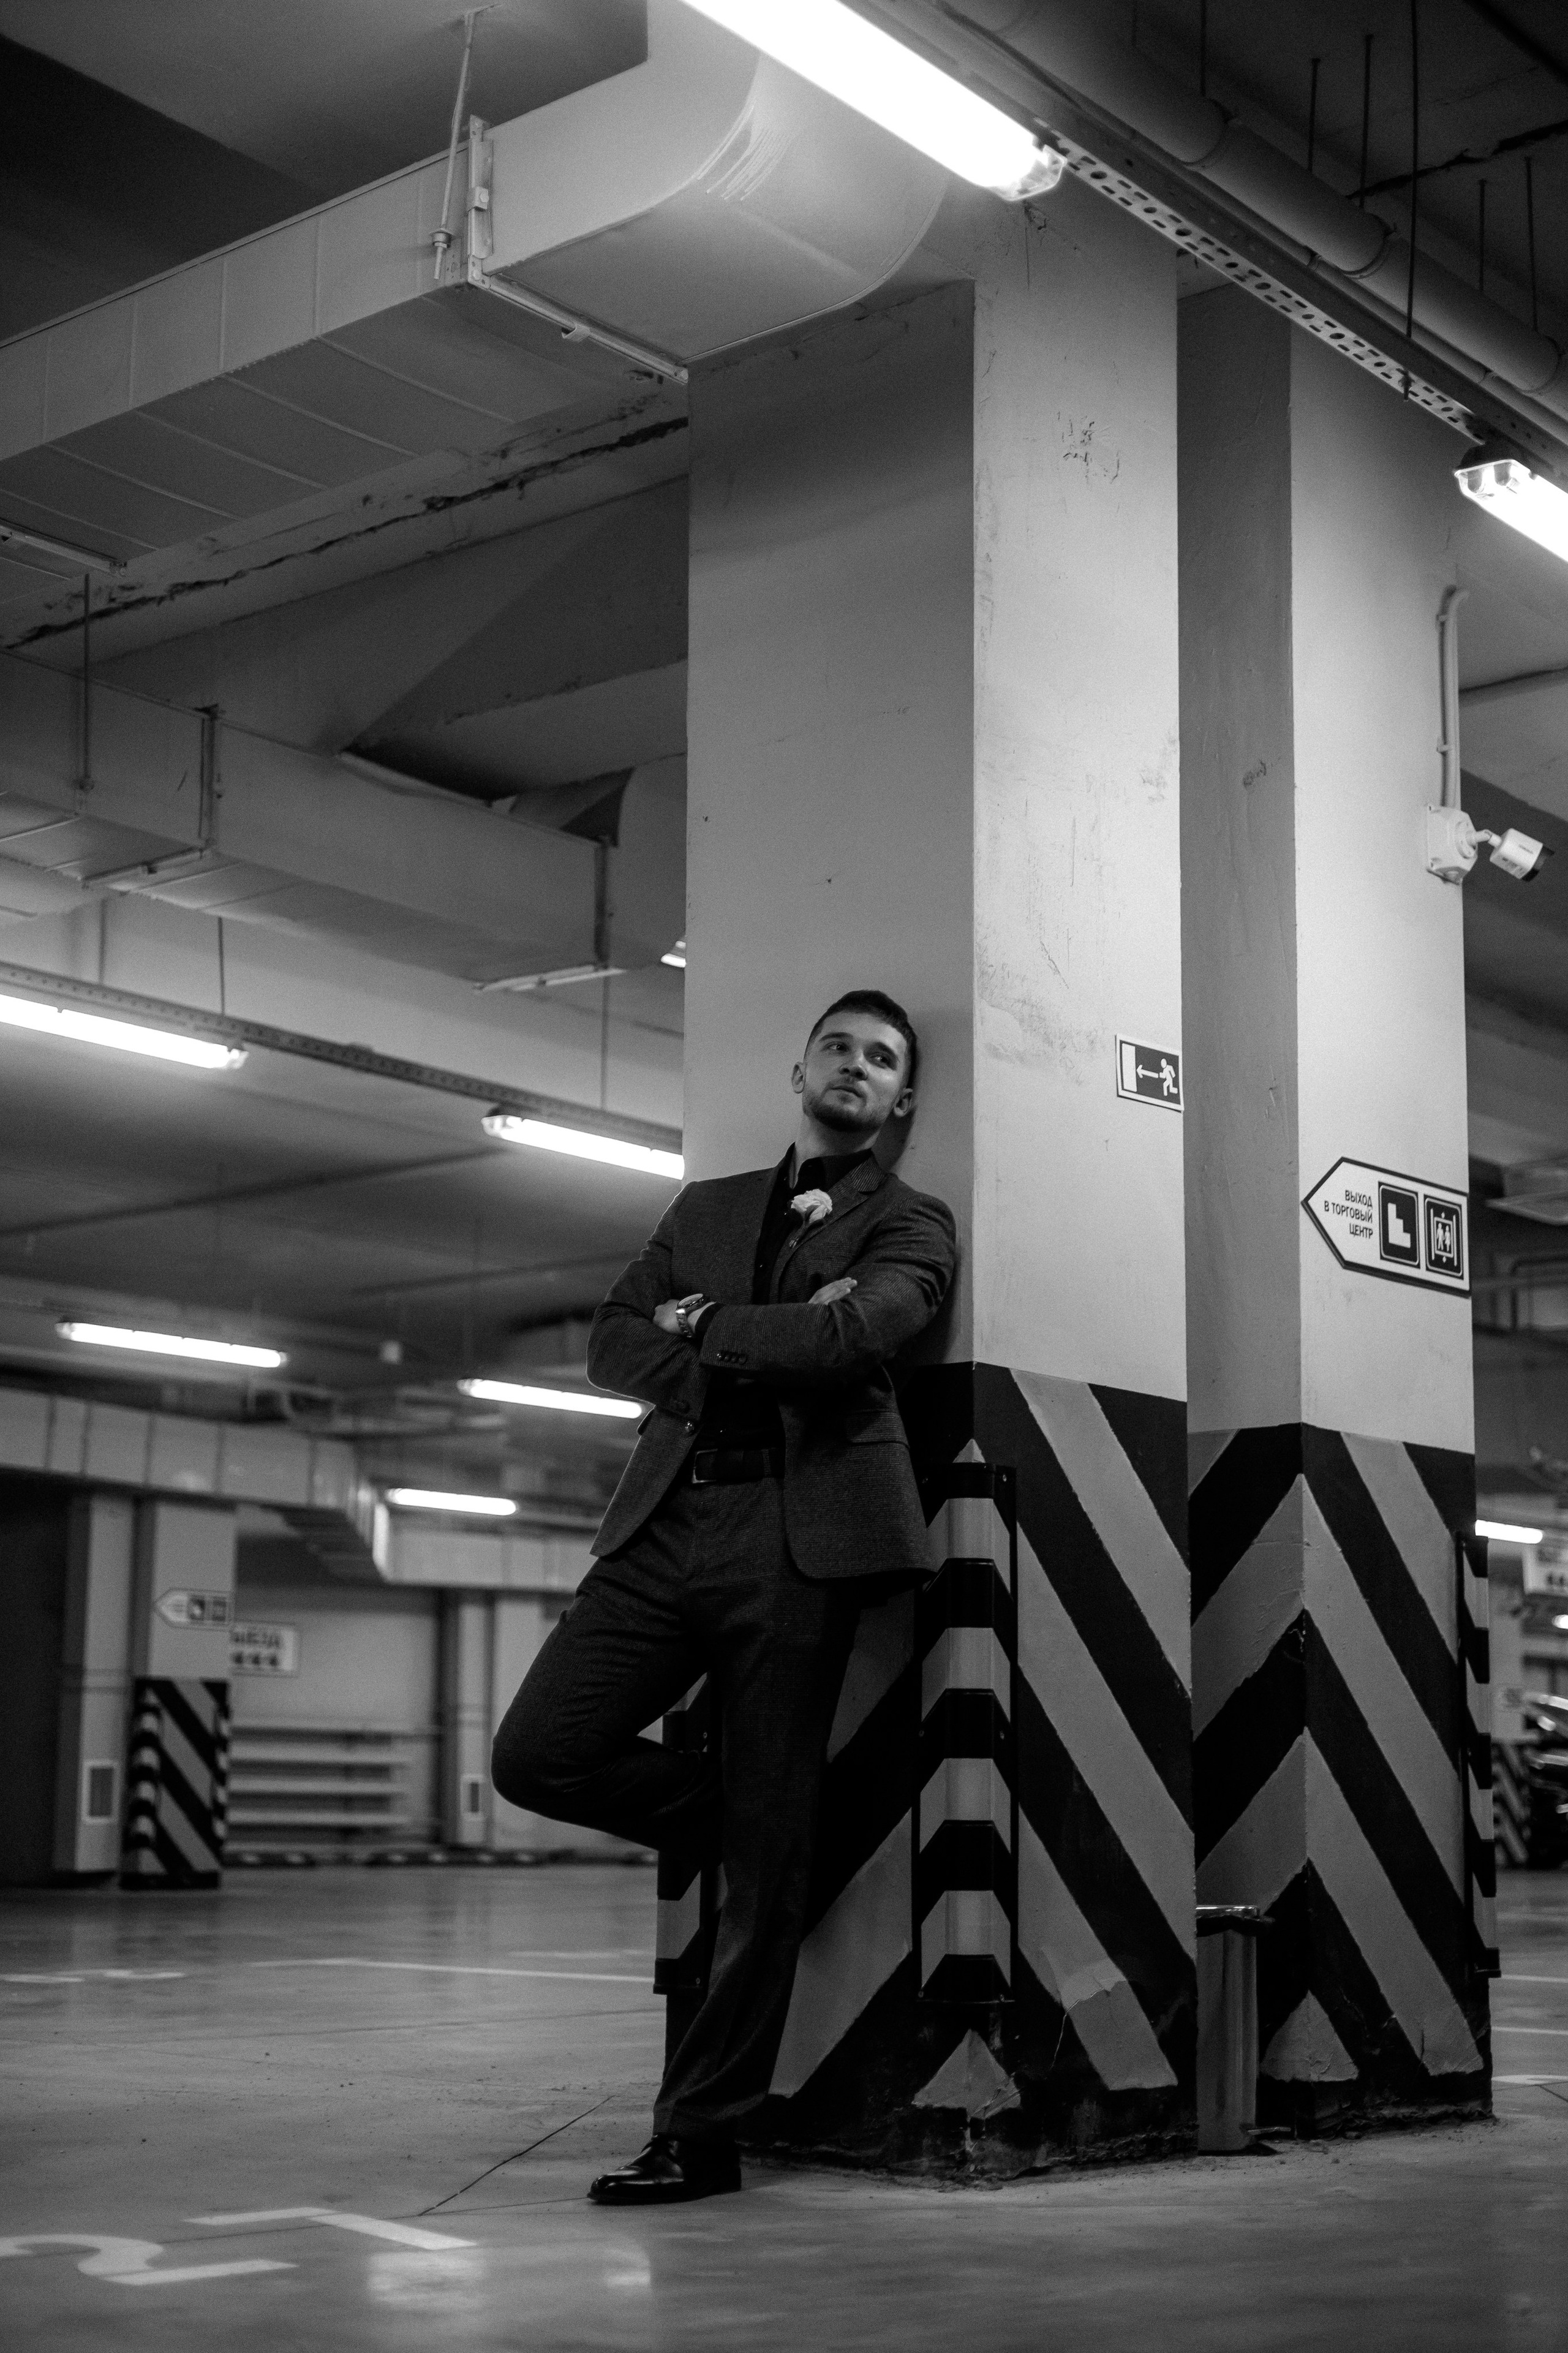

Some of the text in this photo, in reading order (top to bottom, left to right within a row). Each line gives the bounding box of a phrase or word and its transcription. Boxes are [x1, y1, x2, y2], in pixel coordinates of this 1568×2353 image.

[1345, 1190, 1373, 1209] ВЫХОД
[1324, 1200, 1373, 1223] В ТОРГОВЫЙ
[1349, 1223, 1373, 1239] ЦЕНТР
